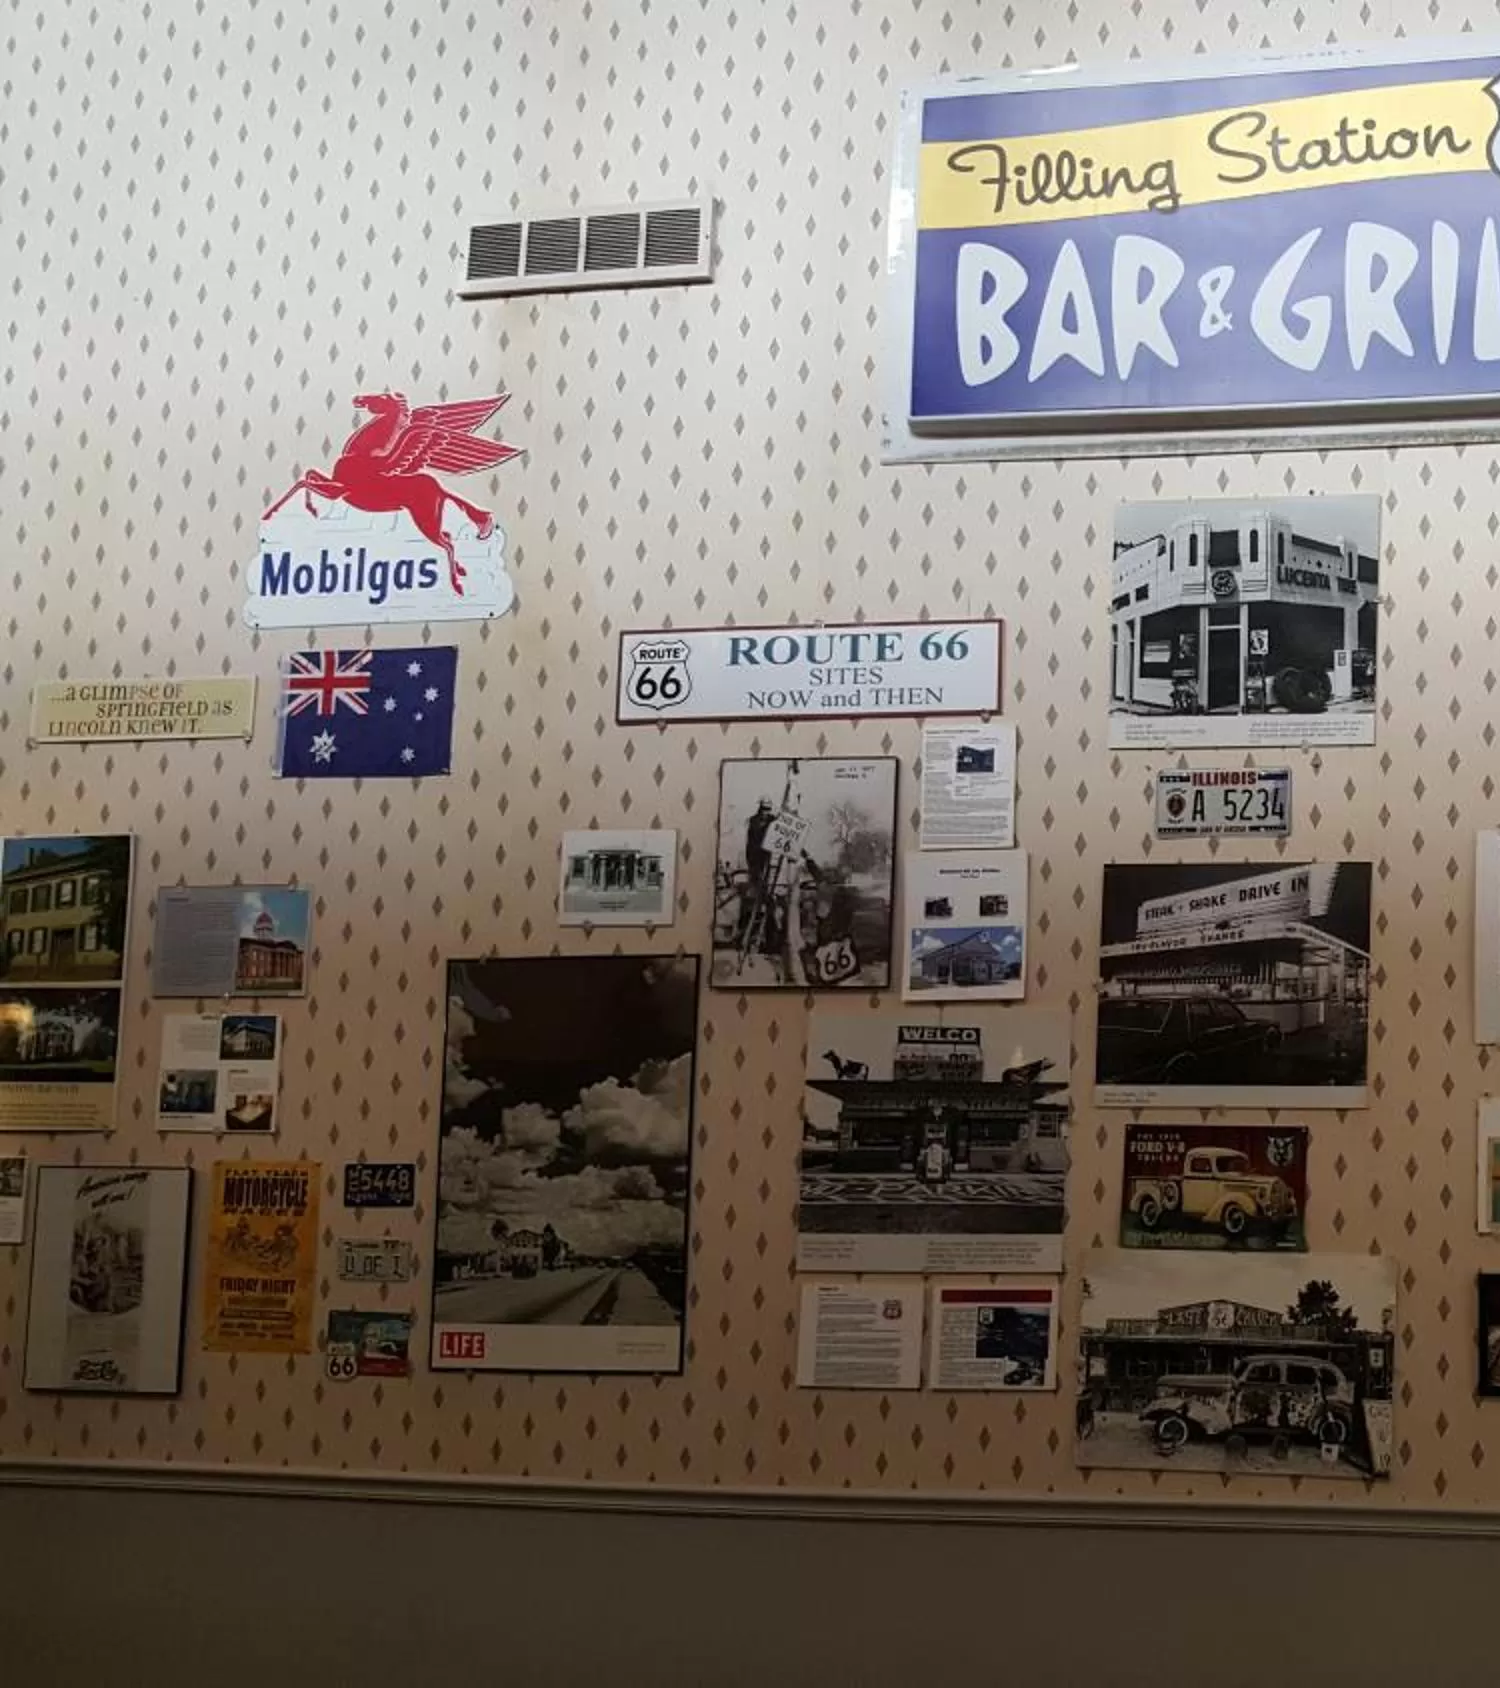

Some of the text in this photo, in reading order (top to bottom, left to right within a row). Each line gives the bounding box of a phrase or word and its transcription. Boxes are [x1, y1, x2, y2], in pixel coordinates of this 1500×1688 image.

[947, 110, 1471, 214] Filling Station
[955, 233, 1186, 387] BAR
[1198, 264, 1236, 338] &
[260, 547, 439, 605] Mobilgas
[639, 647, 682, 662] ROUTE
[726, 629, 970, 667] ROUTE 66
[635, 667, 682, 700] 66
[809, 667, 884, 686] SITES
[748, 686, 944, 710] NOW and THEN
[1192, 771, 1257, 786] ILLINOIS
[1192, 788, 1284, 821] A 5234
[1239, 881, 1281, 901] DRIVE
[1291, 876, 1309, 893] IN
[824, 946, 850, 974] 66
[901, 1027, 977, 1042] WELCO
[223, 1177, 309, 1208] MOTORCYCLE
[442, 1335, 483, 1356] LIFE
[329, 1358, 355, 1377] 66
